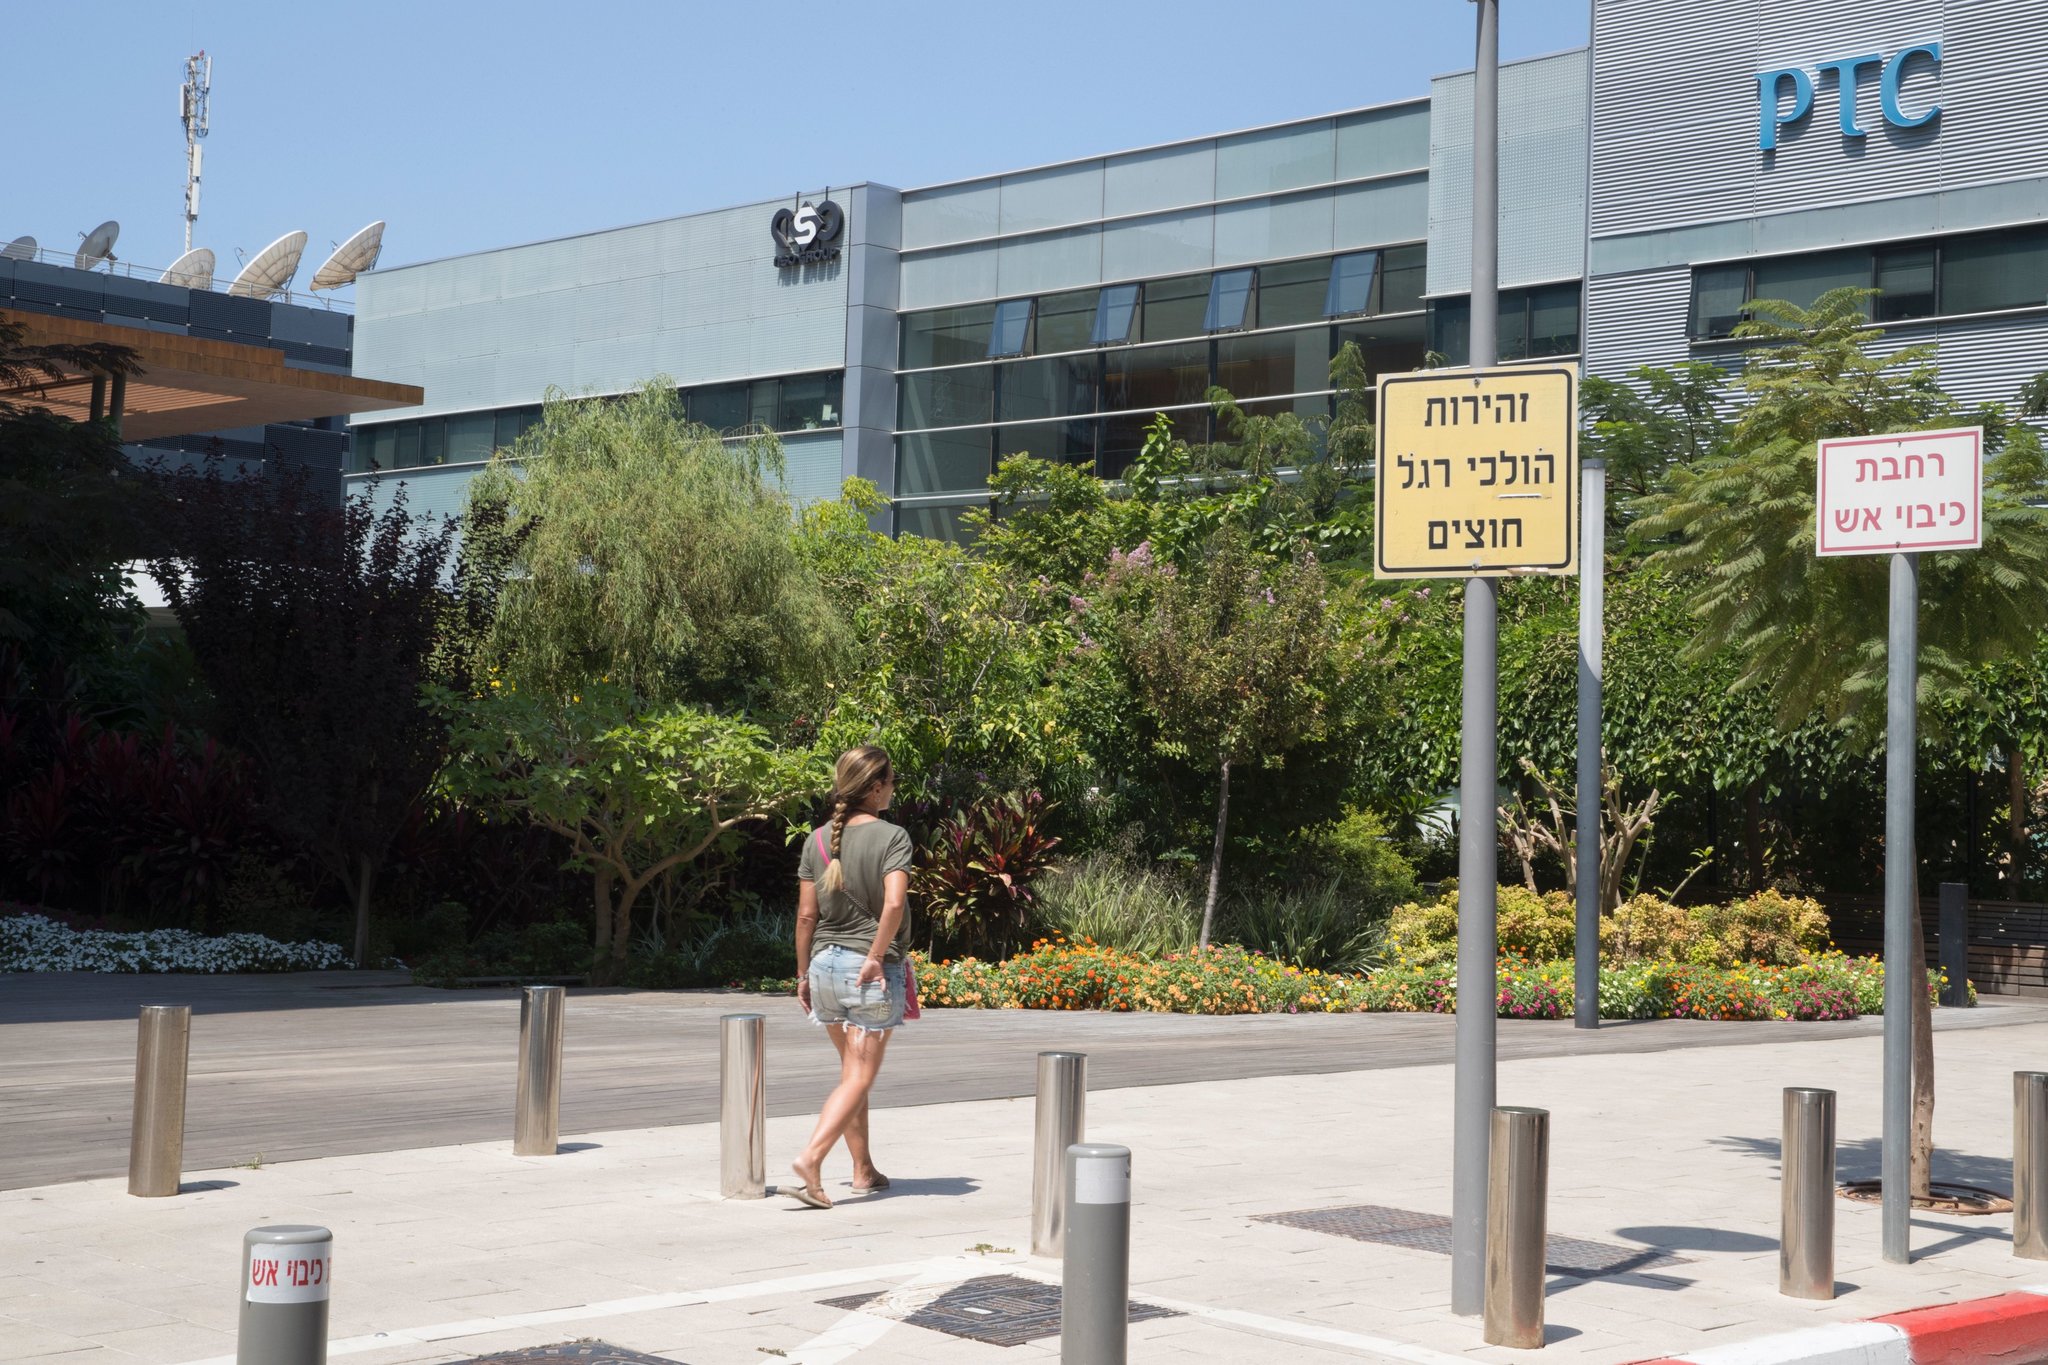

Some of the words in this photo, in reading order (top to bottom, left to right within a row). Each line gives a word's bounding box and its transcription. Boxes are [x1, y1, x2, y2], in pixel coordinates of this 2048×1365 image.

[1754, 42, 1943, 150] PTC
[1424, 393, 1529, 427] זהירות
[1397, 455, 1450, 489] רגל
[1467, 450, 1554, 486] הולכי
[1855, 453, 1944, 482] רחבת
[1834, 507, 1882, 533] אש
[1896, 502, 1966, 529] כיבוי
[1428, 518, 1522, 549] חוצים
[252, 1258, 279, 1286] אש
[286, 1258, 323, 1286] כיבוי
